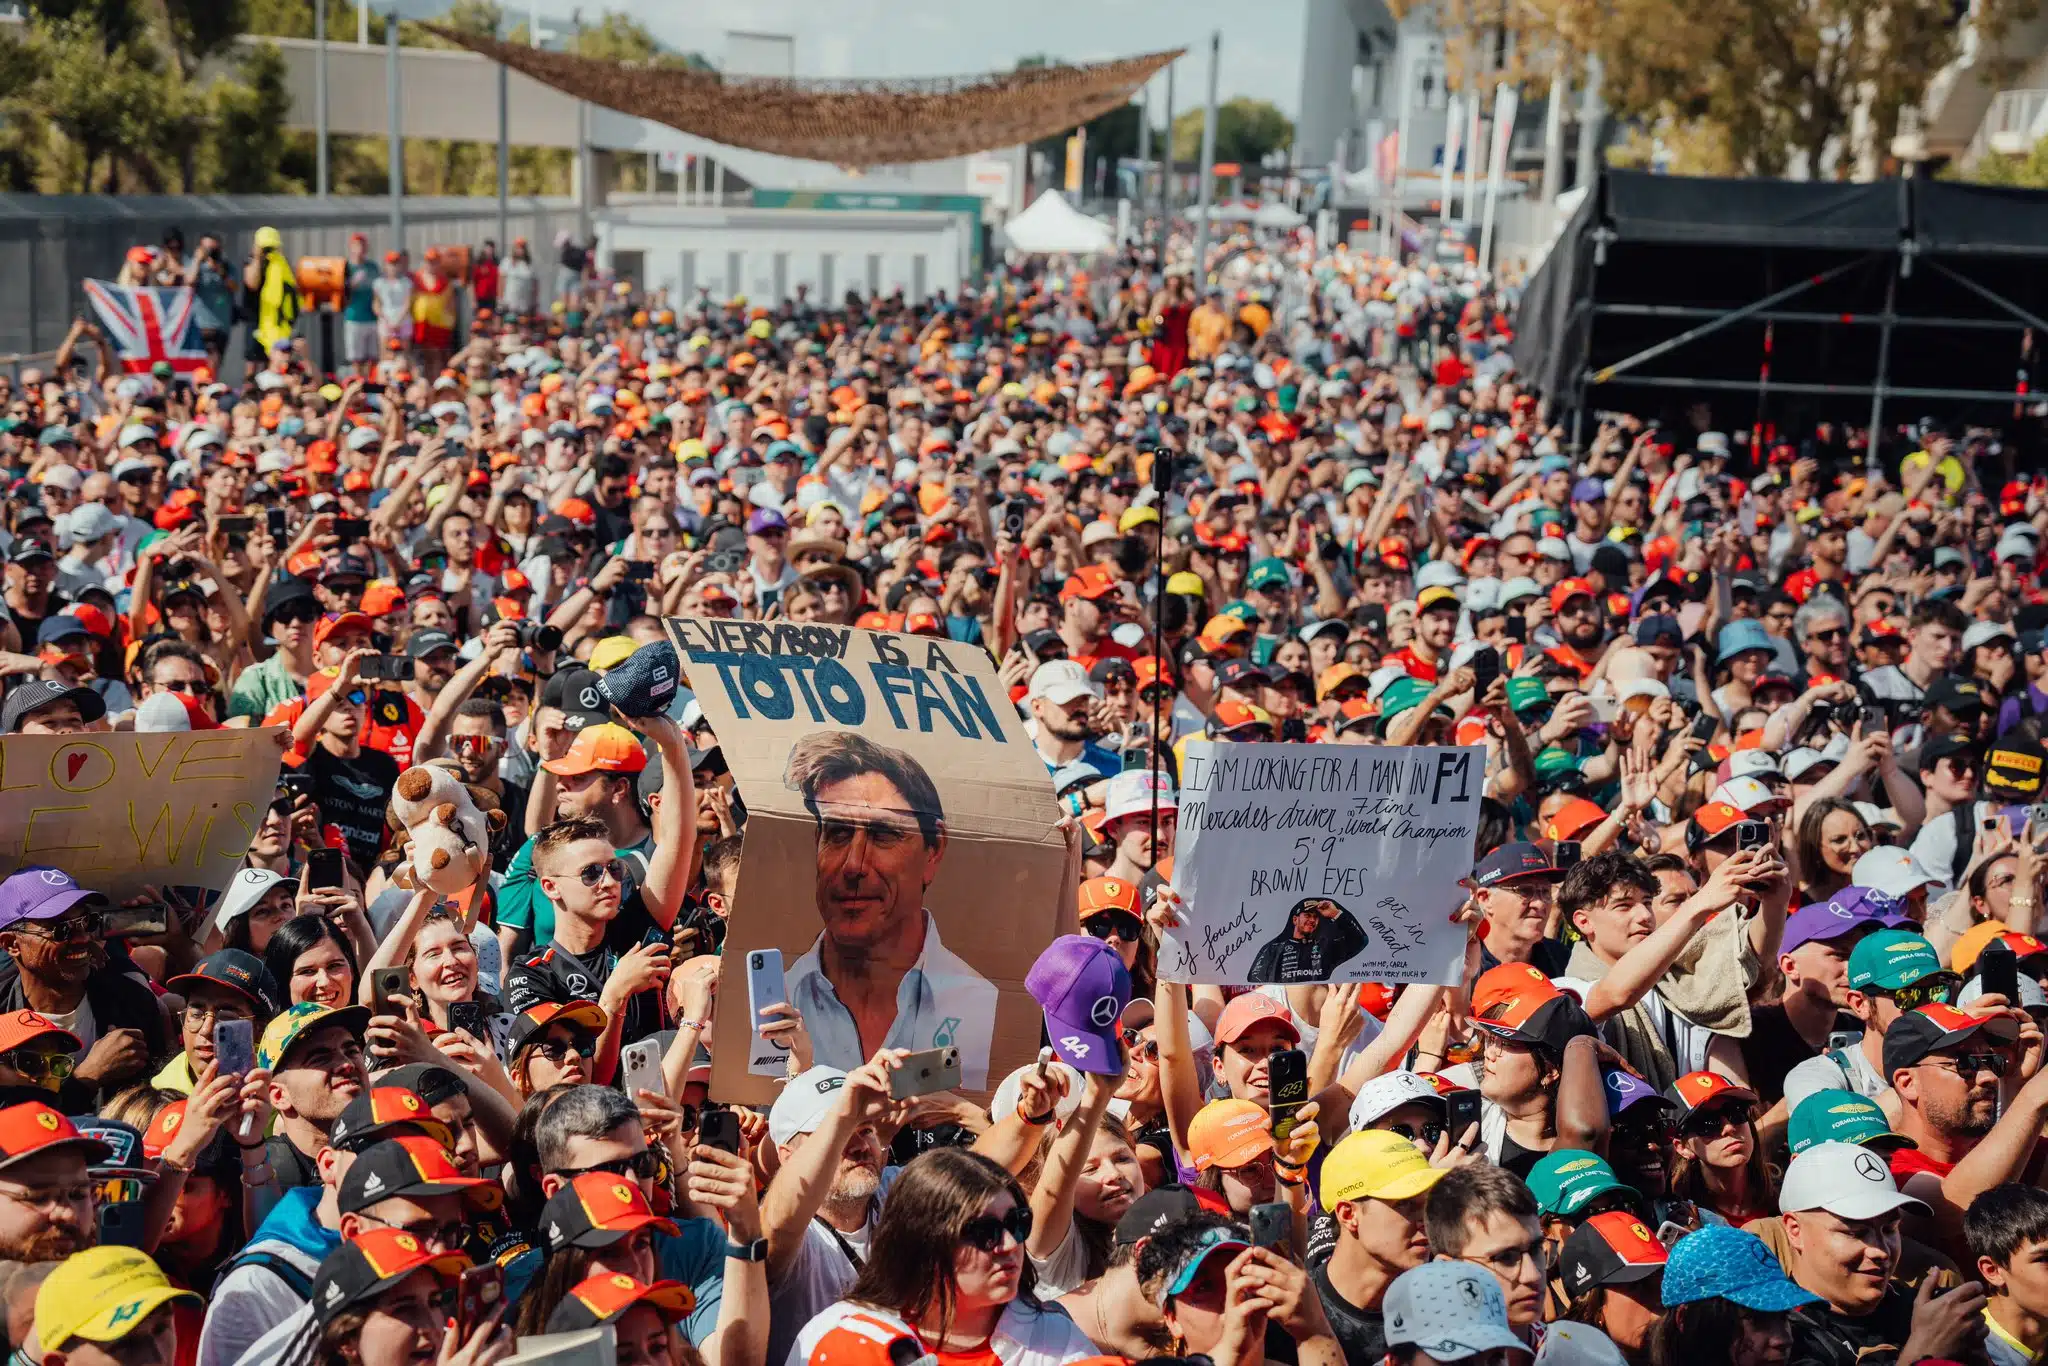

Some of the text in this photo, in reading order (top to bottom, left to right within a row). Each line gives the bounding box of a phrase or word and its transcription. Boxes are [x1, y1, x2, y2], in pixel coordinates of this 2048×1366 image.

[668, 618, 959, 673] EVERYBODY IS A
[687, 651, 1008, 743] TOTO FAN
[0, 737, 245, 793] LOVE
[1186, 757, 1205, 791] I
[1204, 758, 1239, 791] AM
[1309, 757, 1342, 792] FOR
[1346, 758, 1358, 791] A
[1369, 759, 1404, 795] MAN
[1431, 752, 1471, 804] F1
[1184, 801, 1277, 831] Mercedes
[1366, 797, 1420, 817] time
[1393, 819, 1471, 848] Champion
[1250, 867, 1368, 897] BROWN EYES
[1376, 896, 1426, 945] get in
[1175, 941, 1199, 975] if
[1202, 901, 1257, 960] found
[1216, 923, 1262, 975] please
[1369, 916, 1410, 958] contact
[509, 976, 528, 988] IWC
[1058, 1035, 1091, 1059] 44
[1278, 1080, 1303, 1097] 44
[1832, 1116, 1861, 1129] FORMULA
[1559, 1173, 1585, 1190] FORMULA
